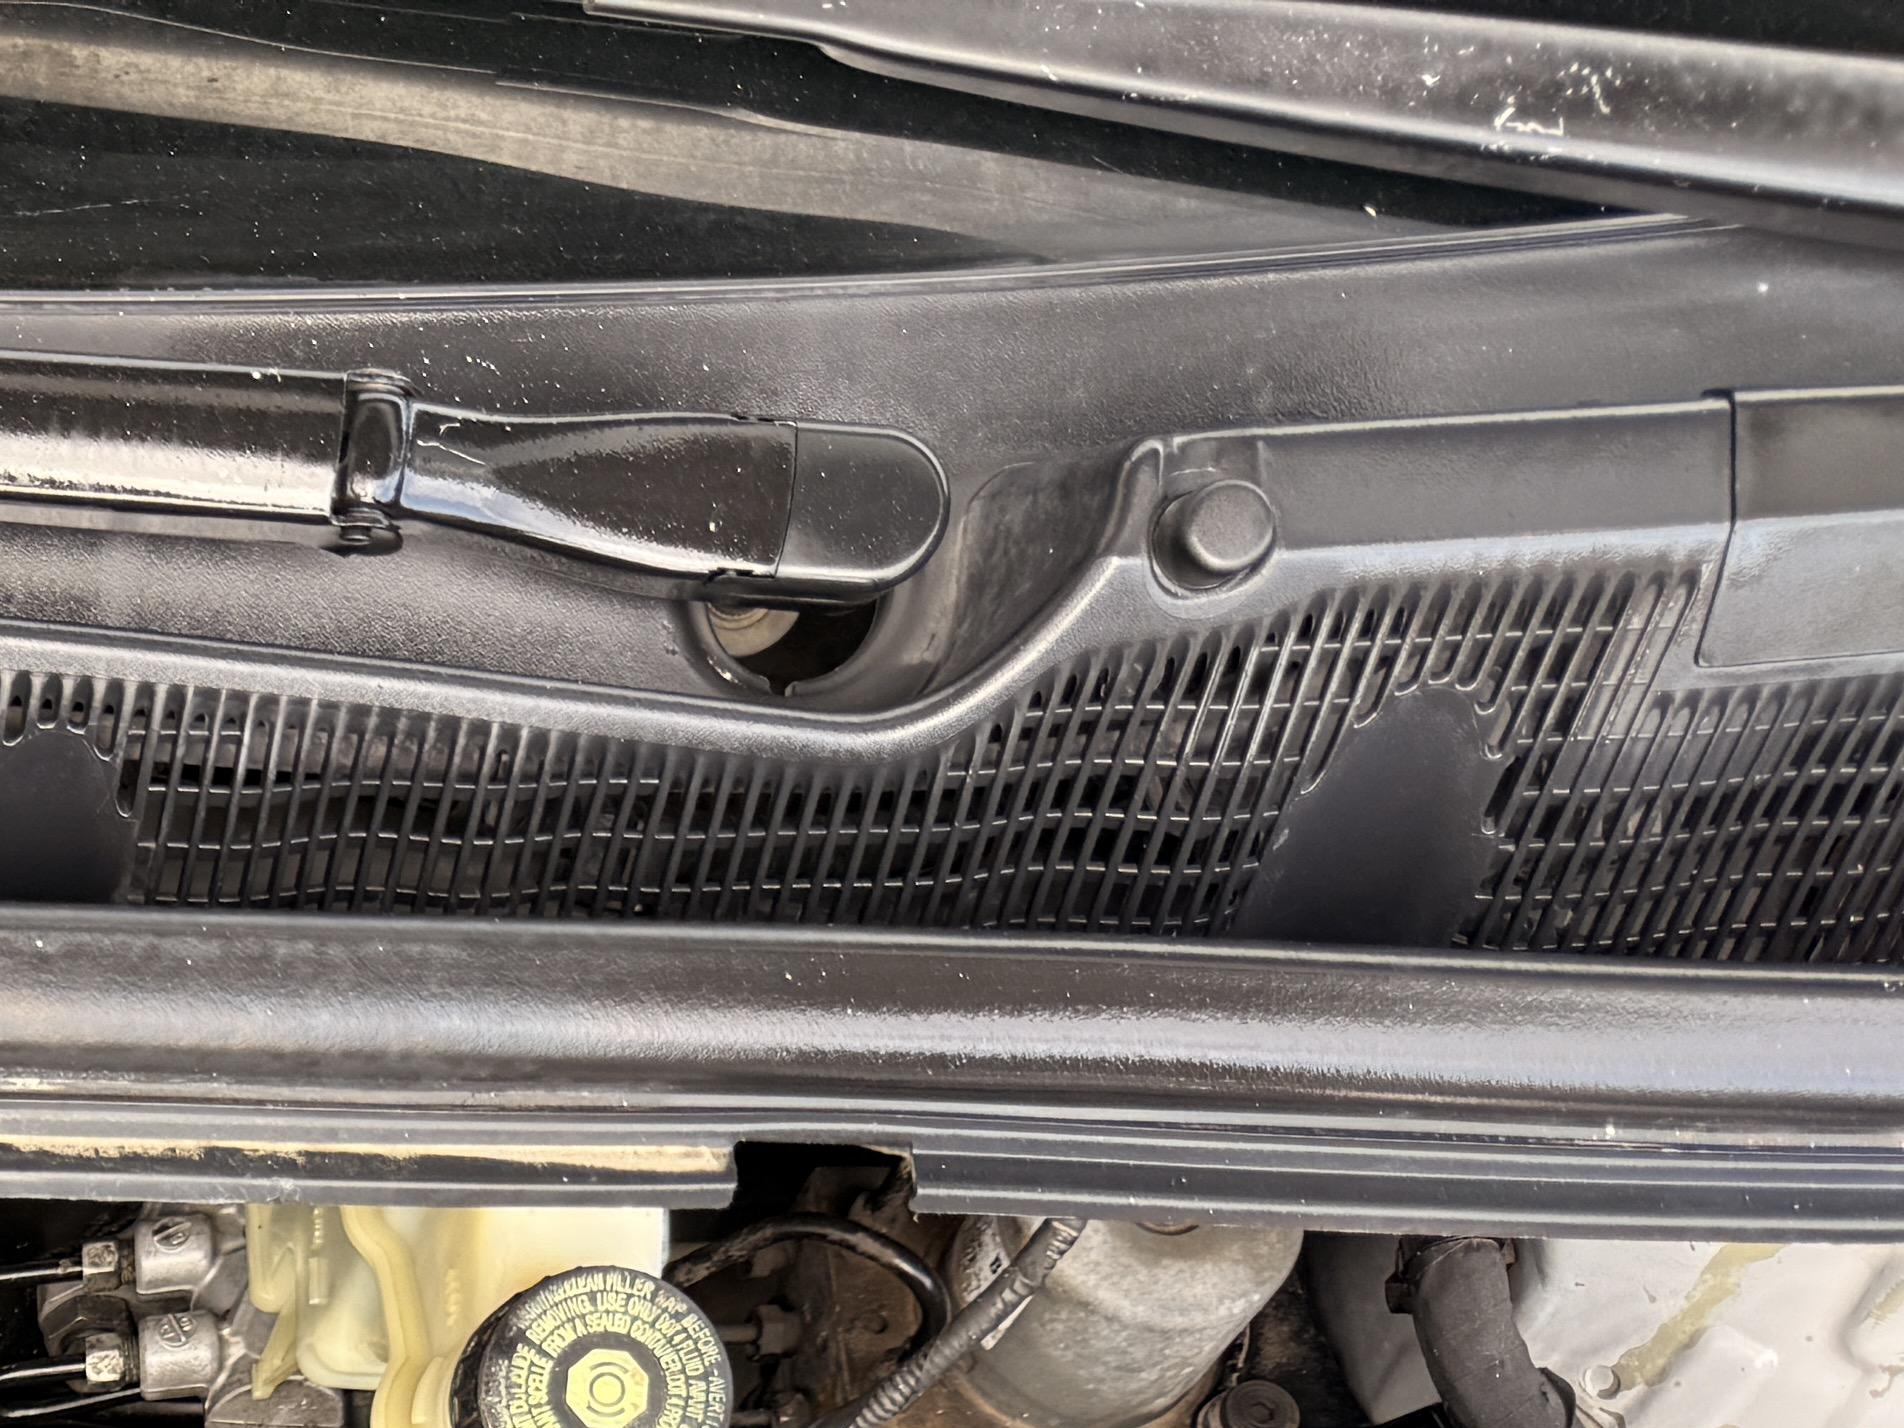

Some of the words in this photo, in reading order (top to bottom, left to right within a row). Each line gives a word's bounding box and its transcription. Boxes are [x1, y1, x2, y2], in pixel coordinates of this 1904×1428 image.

[596, 1291, 626, 1312] USE
[626, 1293, 662, 1324] ONLY
[584, 1311, 633, 1334] SEALED
[654, 1309, 683, 1338] DOT
[669, 1327, 690, 1345] 4
[680, 1309, 722, 1365] BEFORE
[675, 1337, 706, 1376] FLUID
